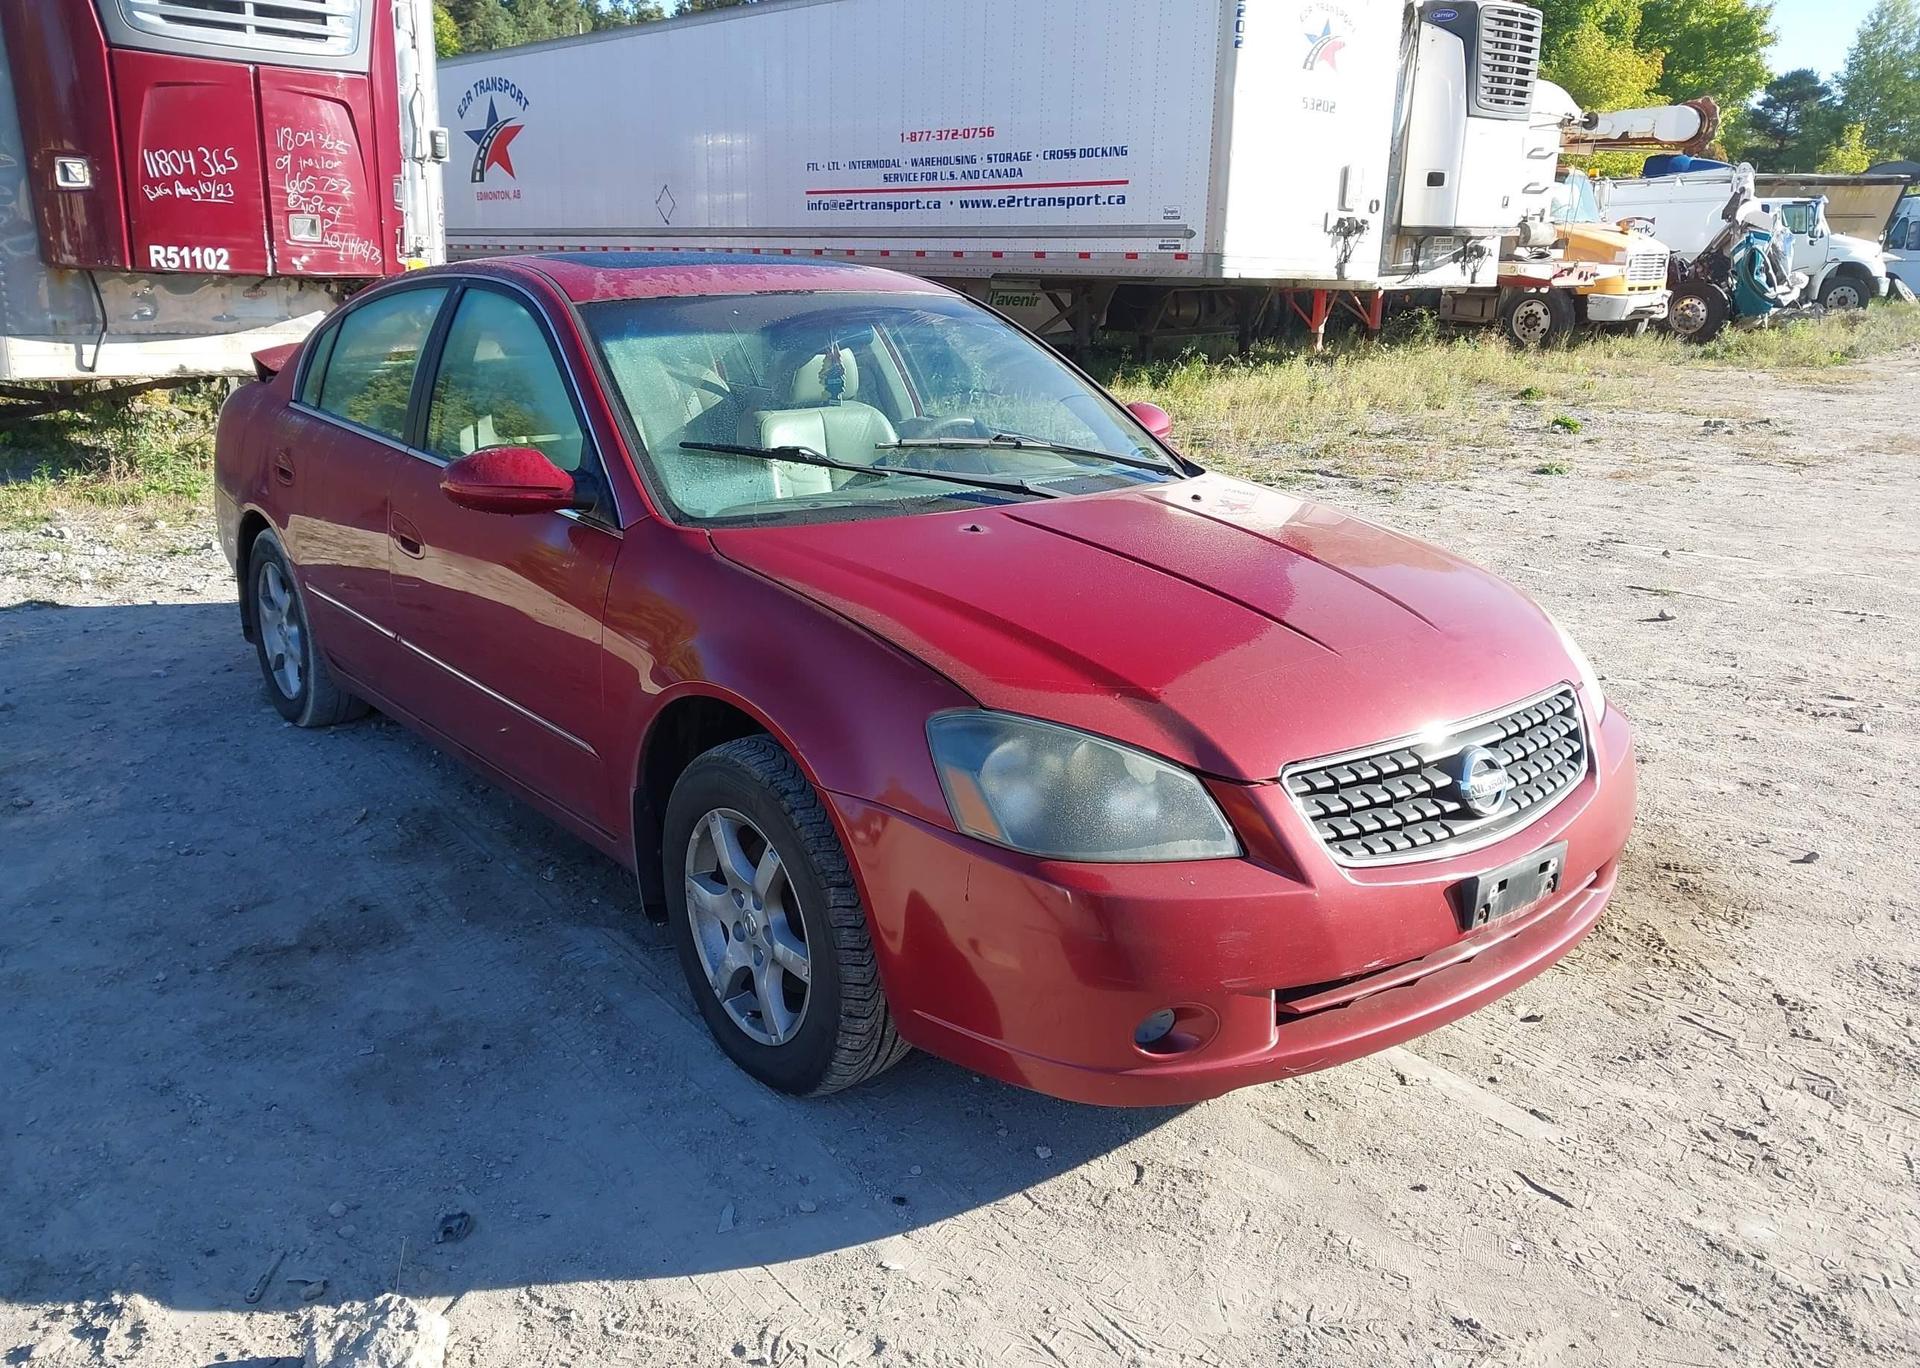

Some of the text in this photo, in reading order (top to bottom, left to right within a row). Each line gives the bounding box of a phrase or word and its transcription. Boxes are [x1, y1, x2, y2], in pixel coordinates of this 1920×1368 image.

[457, 76, 530, 119] E2R TRANSPORT
[1302, 96, 1336, 114] 53202
[900, 126, 995, 143] 1-877-372-0756
[806, 145, 1129, 172] FTL LTL INTERMODAL WAREHOUSING STORAGE CROSS DOCKING
[883, 167, 1024, 183] SERVICE FOR U.S. AND CANADA
[513, 189, 521, 200] AB
[806, 193, 1127, 213] info@e2rtransport.ca www.e2rtransport.ca
[149, 244, 231, 271] R51102
[989, 290, 1041, 307] l'avenir
